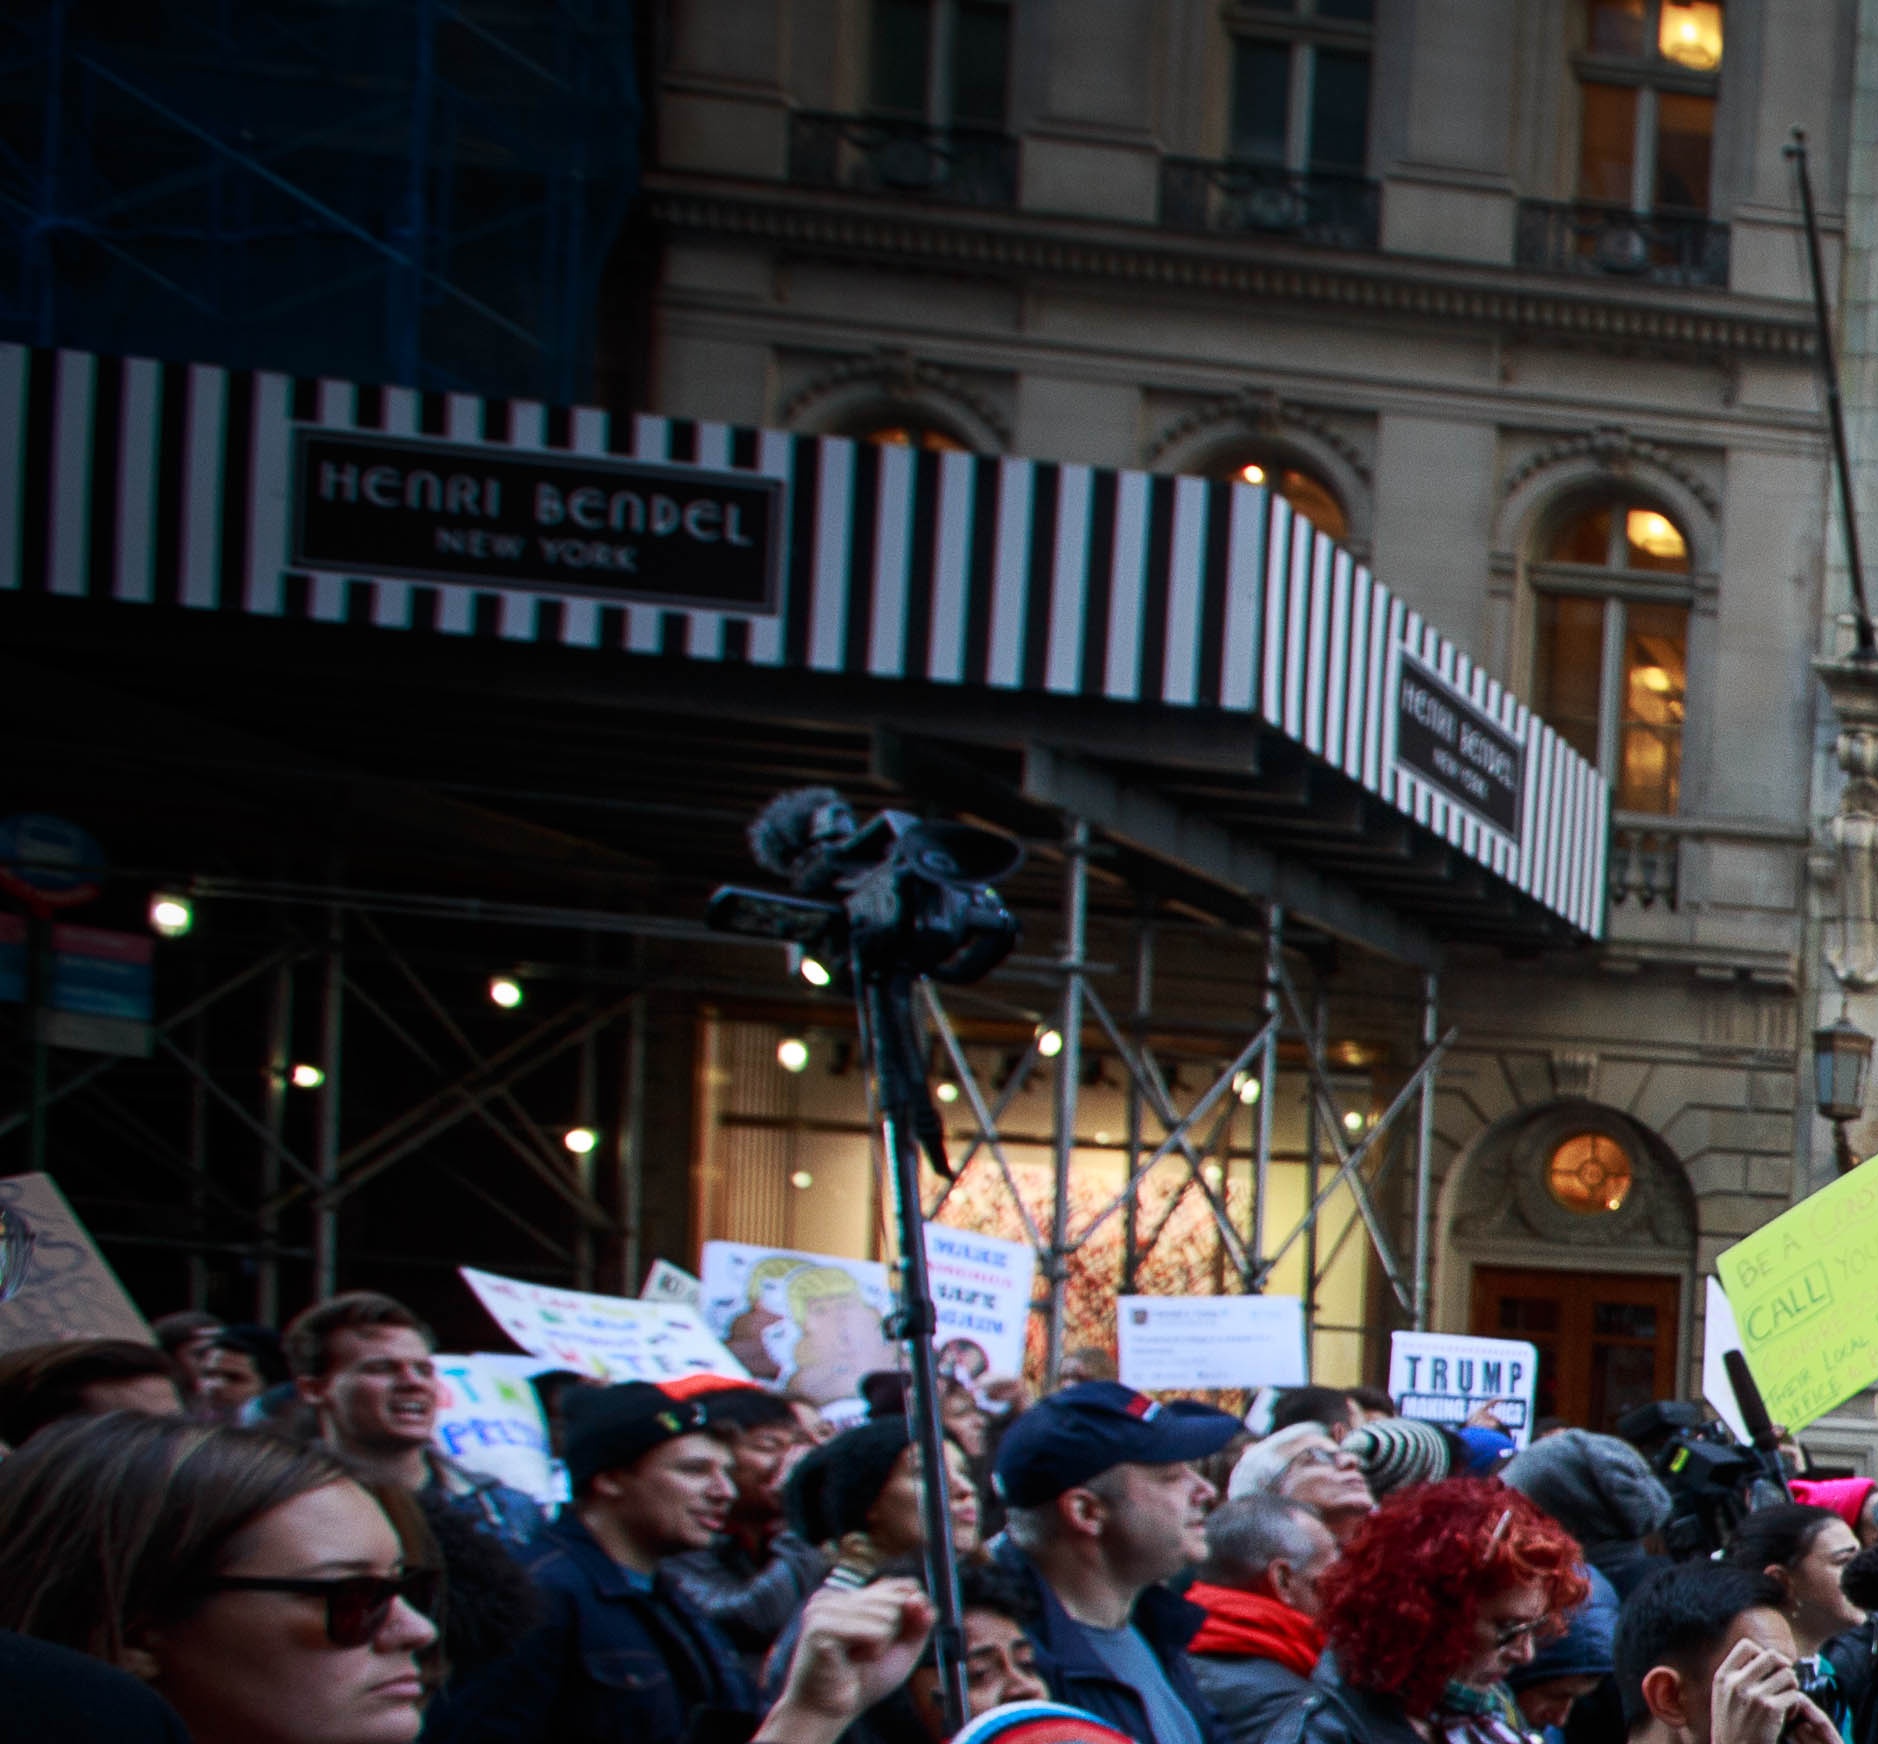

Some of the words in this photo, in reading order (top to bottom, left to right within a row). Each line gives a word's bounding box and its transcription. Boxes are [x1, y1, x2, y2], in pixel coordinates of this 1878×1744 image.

[317, 459, 502, 519] HENRI
[532, 480, 755, 548] BENDEL
[433, 527, 527, 561] NEW
[537, 535, 641, 574] YORK
[1737, 1248, 1771, 1288] BE
[1784, 1233, 1801, 1260] A
[1748, 1275, 1827, 1342] CALL
[1404, 1356, 1522, 1393] TRUMP
